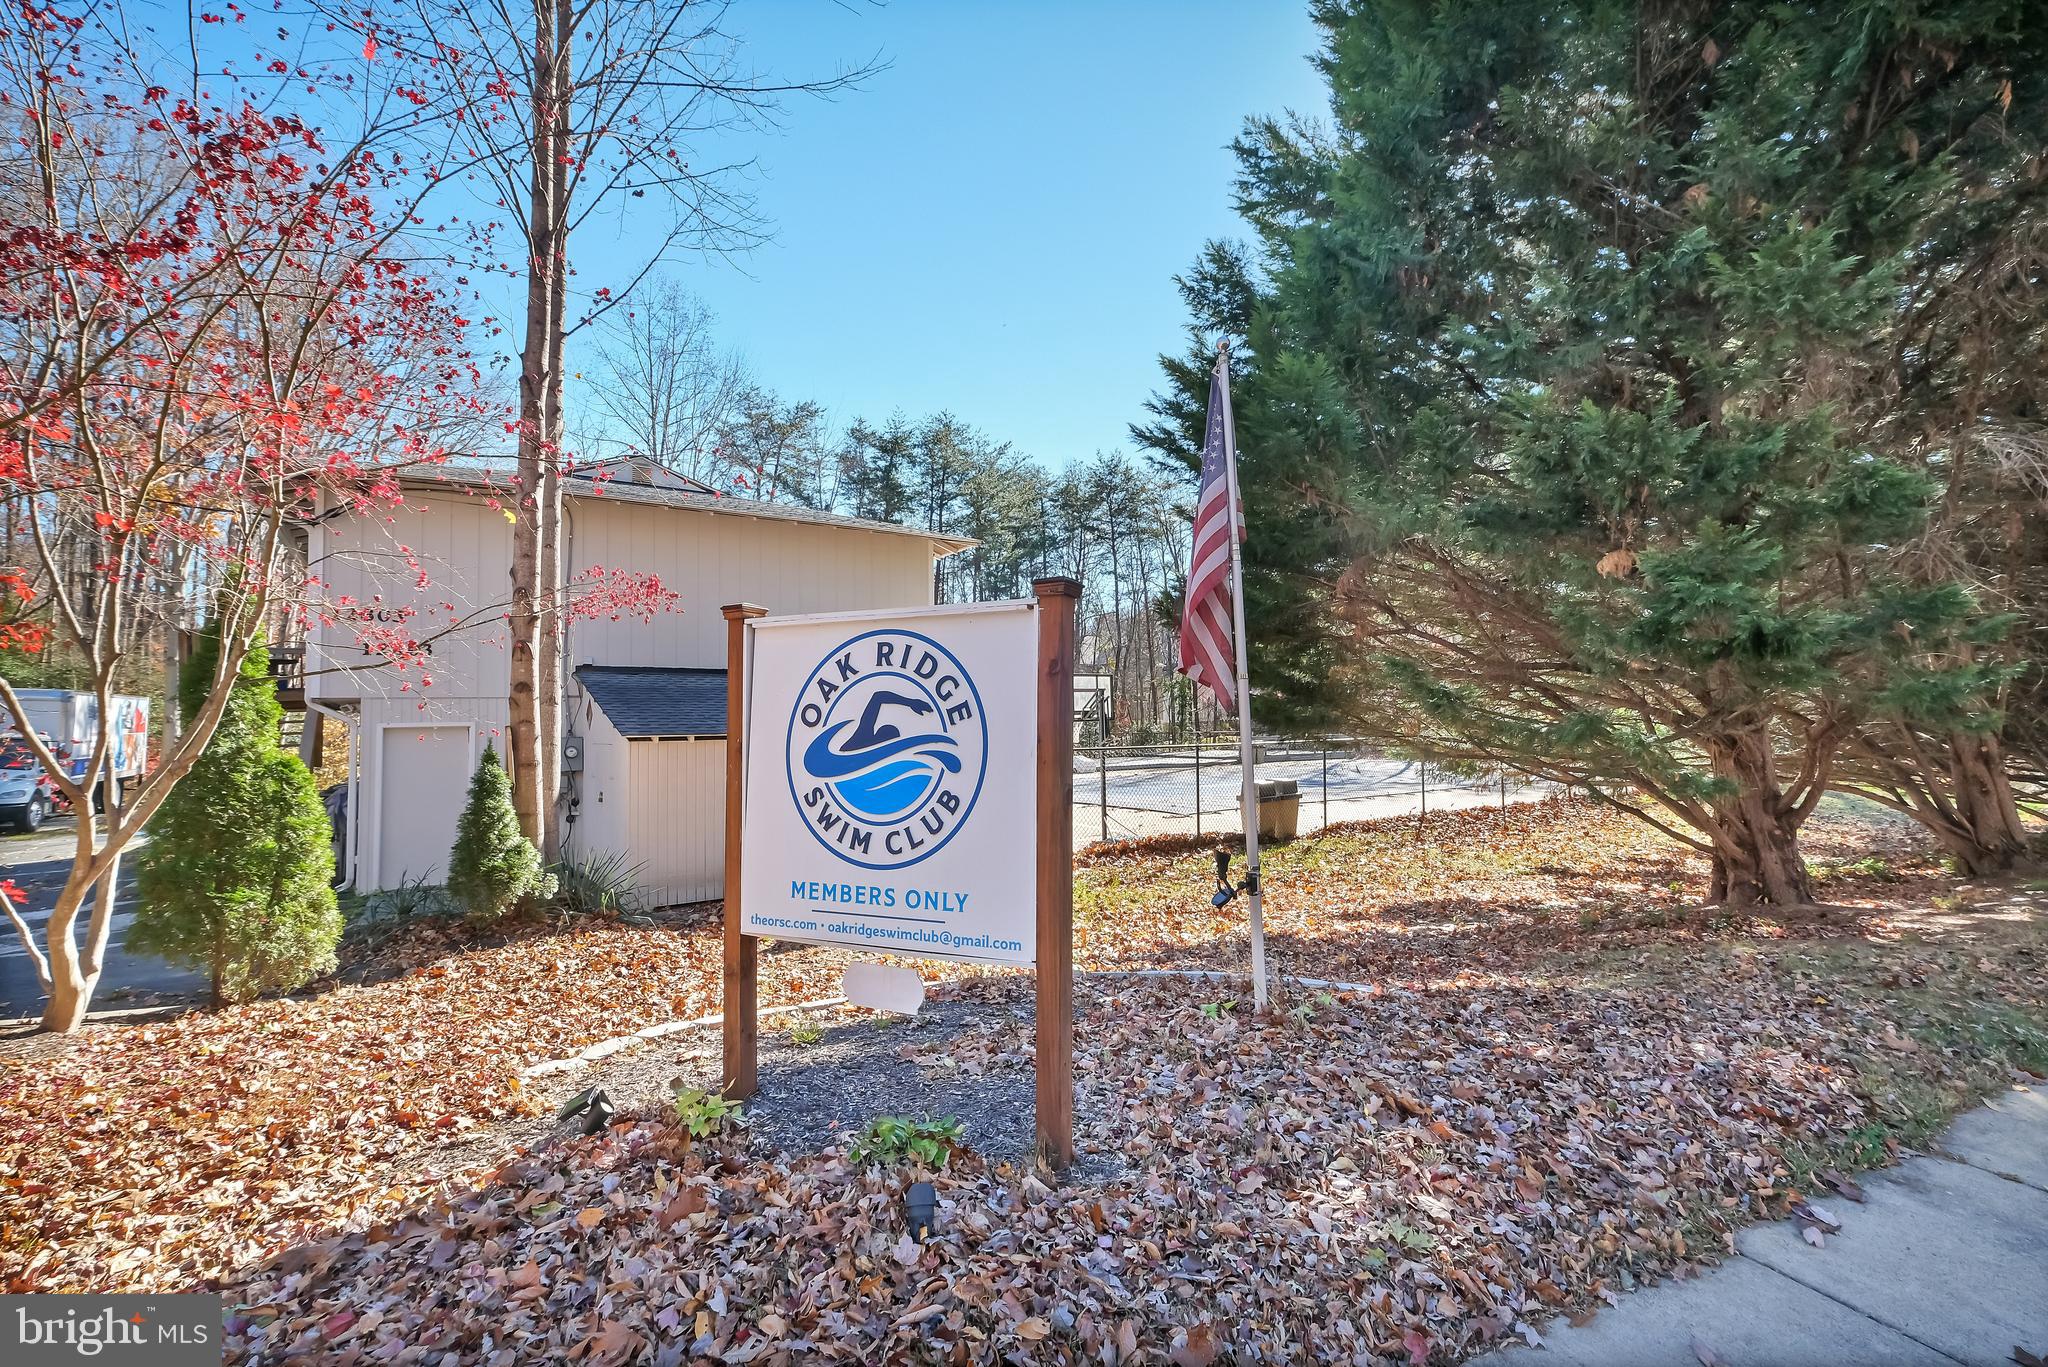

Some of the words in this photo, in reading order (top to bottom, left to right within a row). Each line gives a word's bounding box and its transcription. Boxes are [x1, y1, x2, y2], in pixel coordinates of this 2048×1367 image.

[801, 652, 859, 728] OAK
[875, 641, 973, 726] RIDGE
[803, 786, 873, 855] SWIM
[885, 789, 961, 855] CLUB
[791, 880, 896, 907] MEMBERS
[905, 888, 969, 913] ONLY
[750, 914, 817, 931] theorsc.com
[828, 921, 1022, 951] oakridgeswimclub@gmail.com
